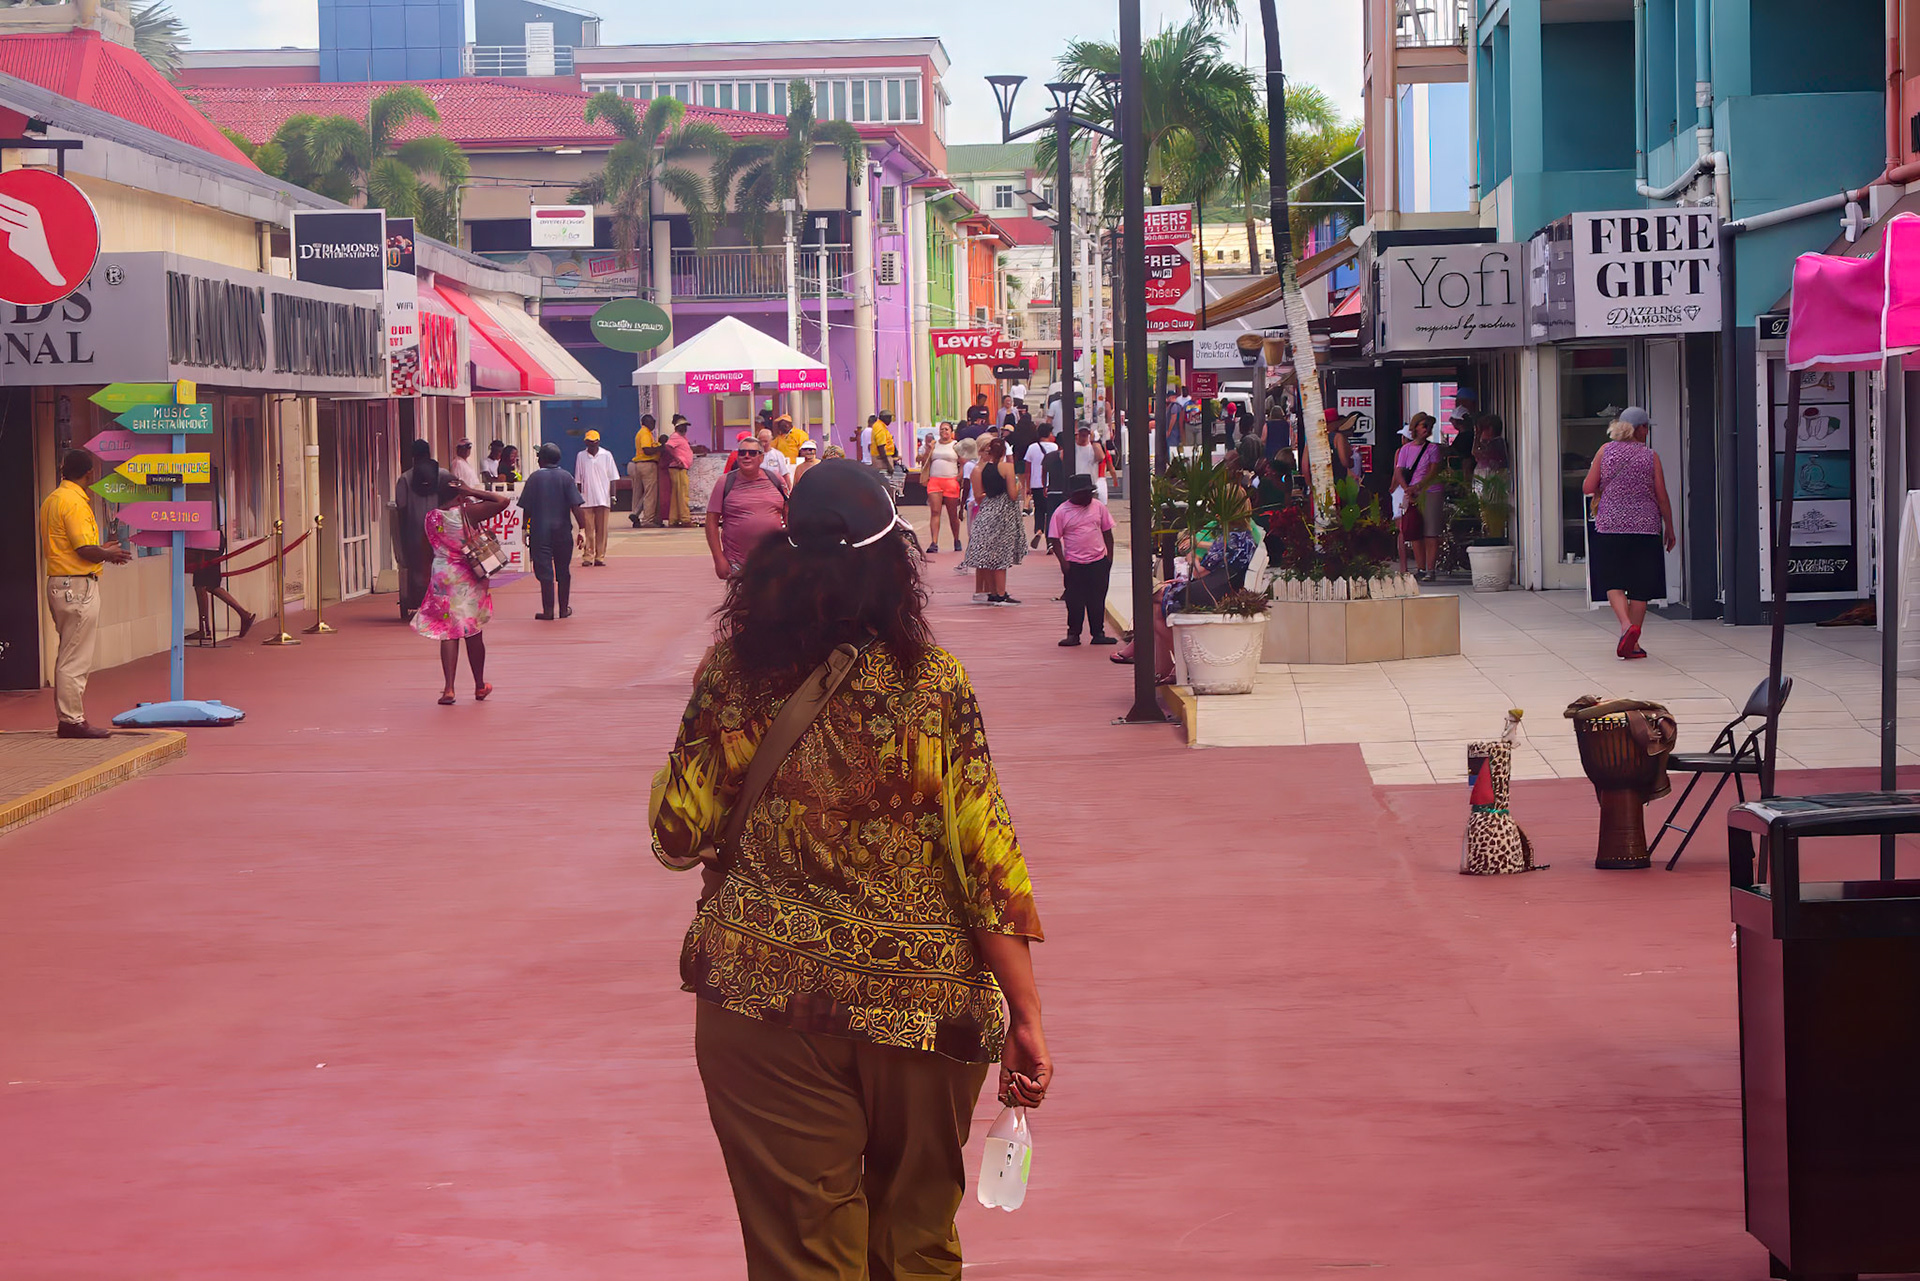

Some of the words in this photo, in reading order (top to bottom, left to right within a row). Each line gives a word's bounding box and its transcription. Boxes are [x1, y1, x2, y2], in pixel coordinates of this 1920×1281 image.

[1588, 213, 1715, 254] FREE
[322, 243, 380, 254] DIAMONDS
[1397, 252, 1517, 309] Yofi
[1596, 258, 1710, 298] GIFT
[1463, 313, 1477, 340] by
[707, 383, 730, 391] TAXI
[1340, 396, 1372, 407] FREE
[154, 407, 191, 418] MUSIC
